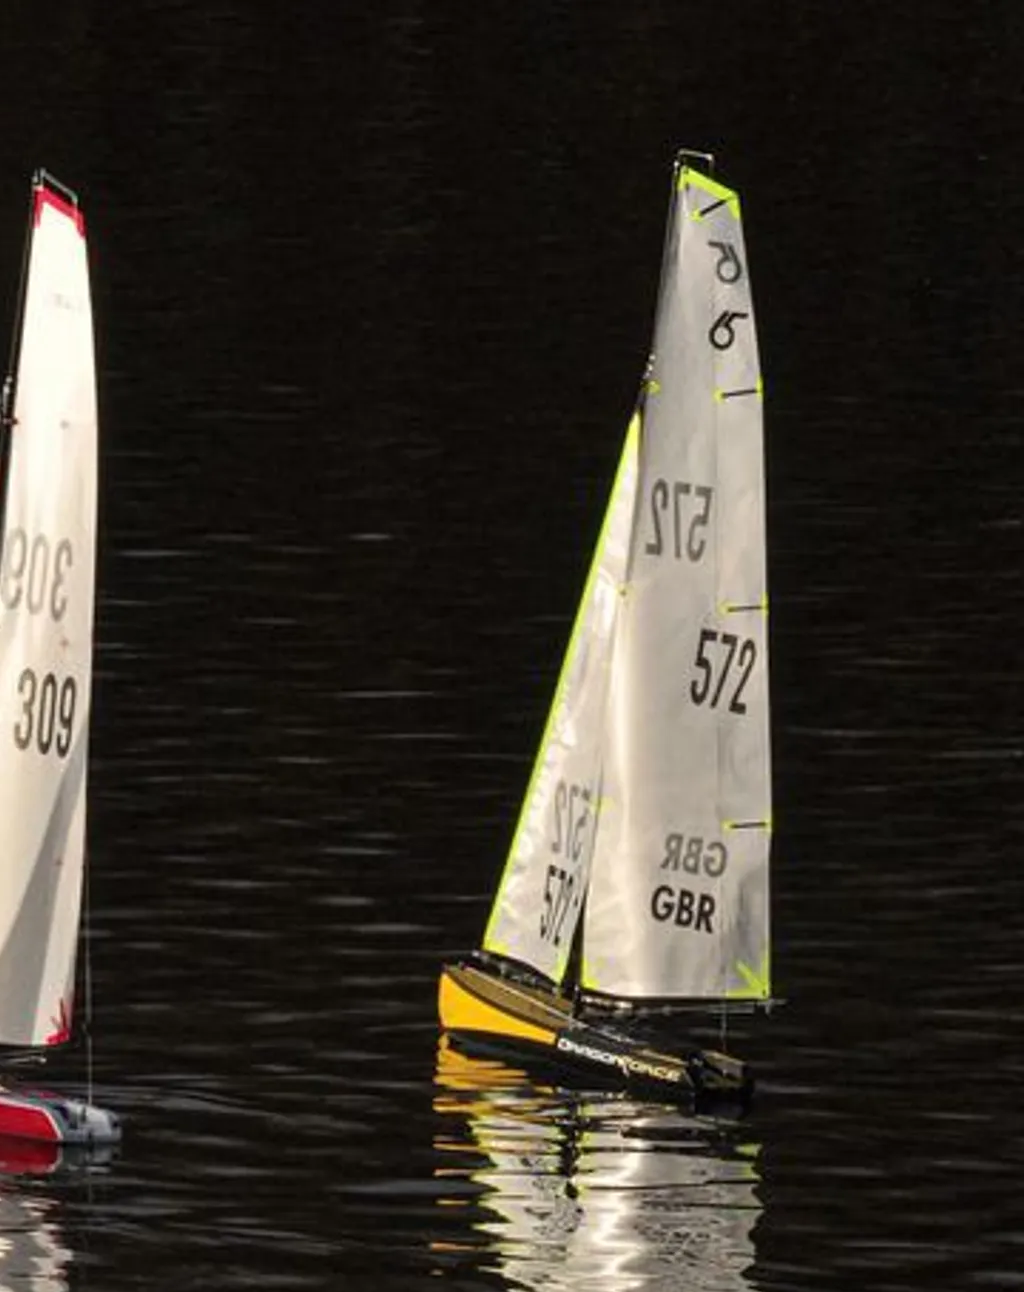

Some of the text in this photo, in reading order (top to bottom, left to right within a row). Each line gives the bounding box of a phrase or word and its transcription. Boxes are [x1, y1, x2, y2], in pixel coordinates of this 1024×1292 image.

[14, 667, 78, 758] 309
[690, 627, 757, 715] 572
[650, 884, 716, 934] GBR
